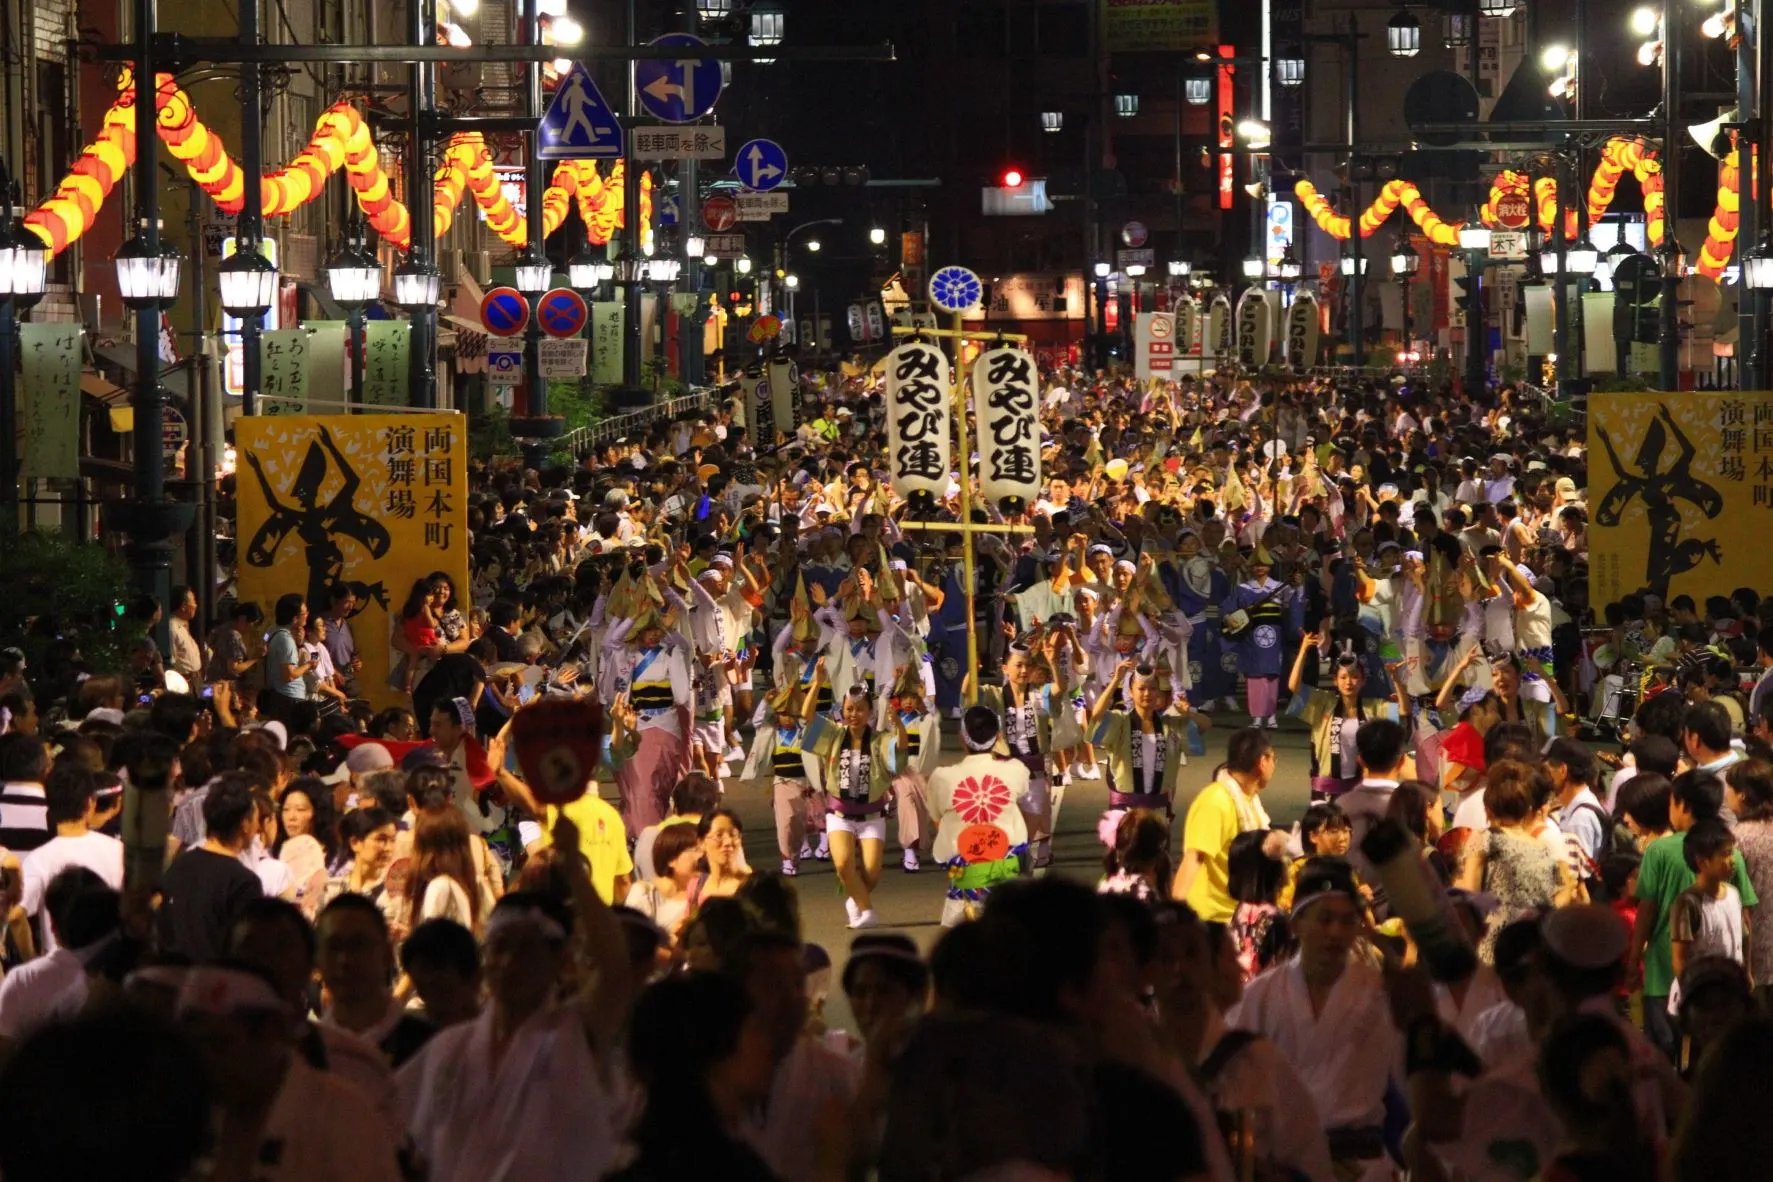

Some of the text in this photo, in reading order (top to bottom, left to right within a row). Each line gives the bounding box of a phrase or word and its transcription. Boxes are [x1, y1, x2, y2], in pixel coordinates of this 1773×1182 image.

[637, 133, 723, 152] 軽車両を除く
[1498, 203, 1527, 217] 消火栓
[896, 348, 945, 481] みやび連
[988, 352, 1037, 484] みやび連
[1719, 399, 1746, 482] 演舞場
[1753, 402, 1773, 509] 両国本町
[385, 424, 417, 520] 演舞場
[423, 424, 453, 551] 両国本町
